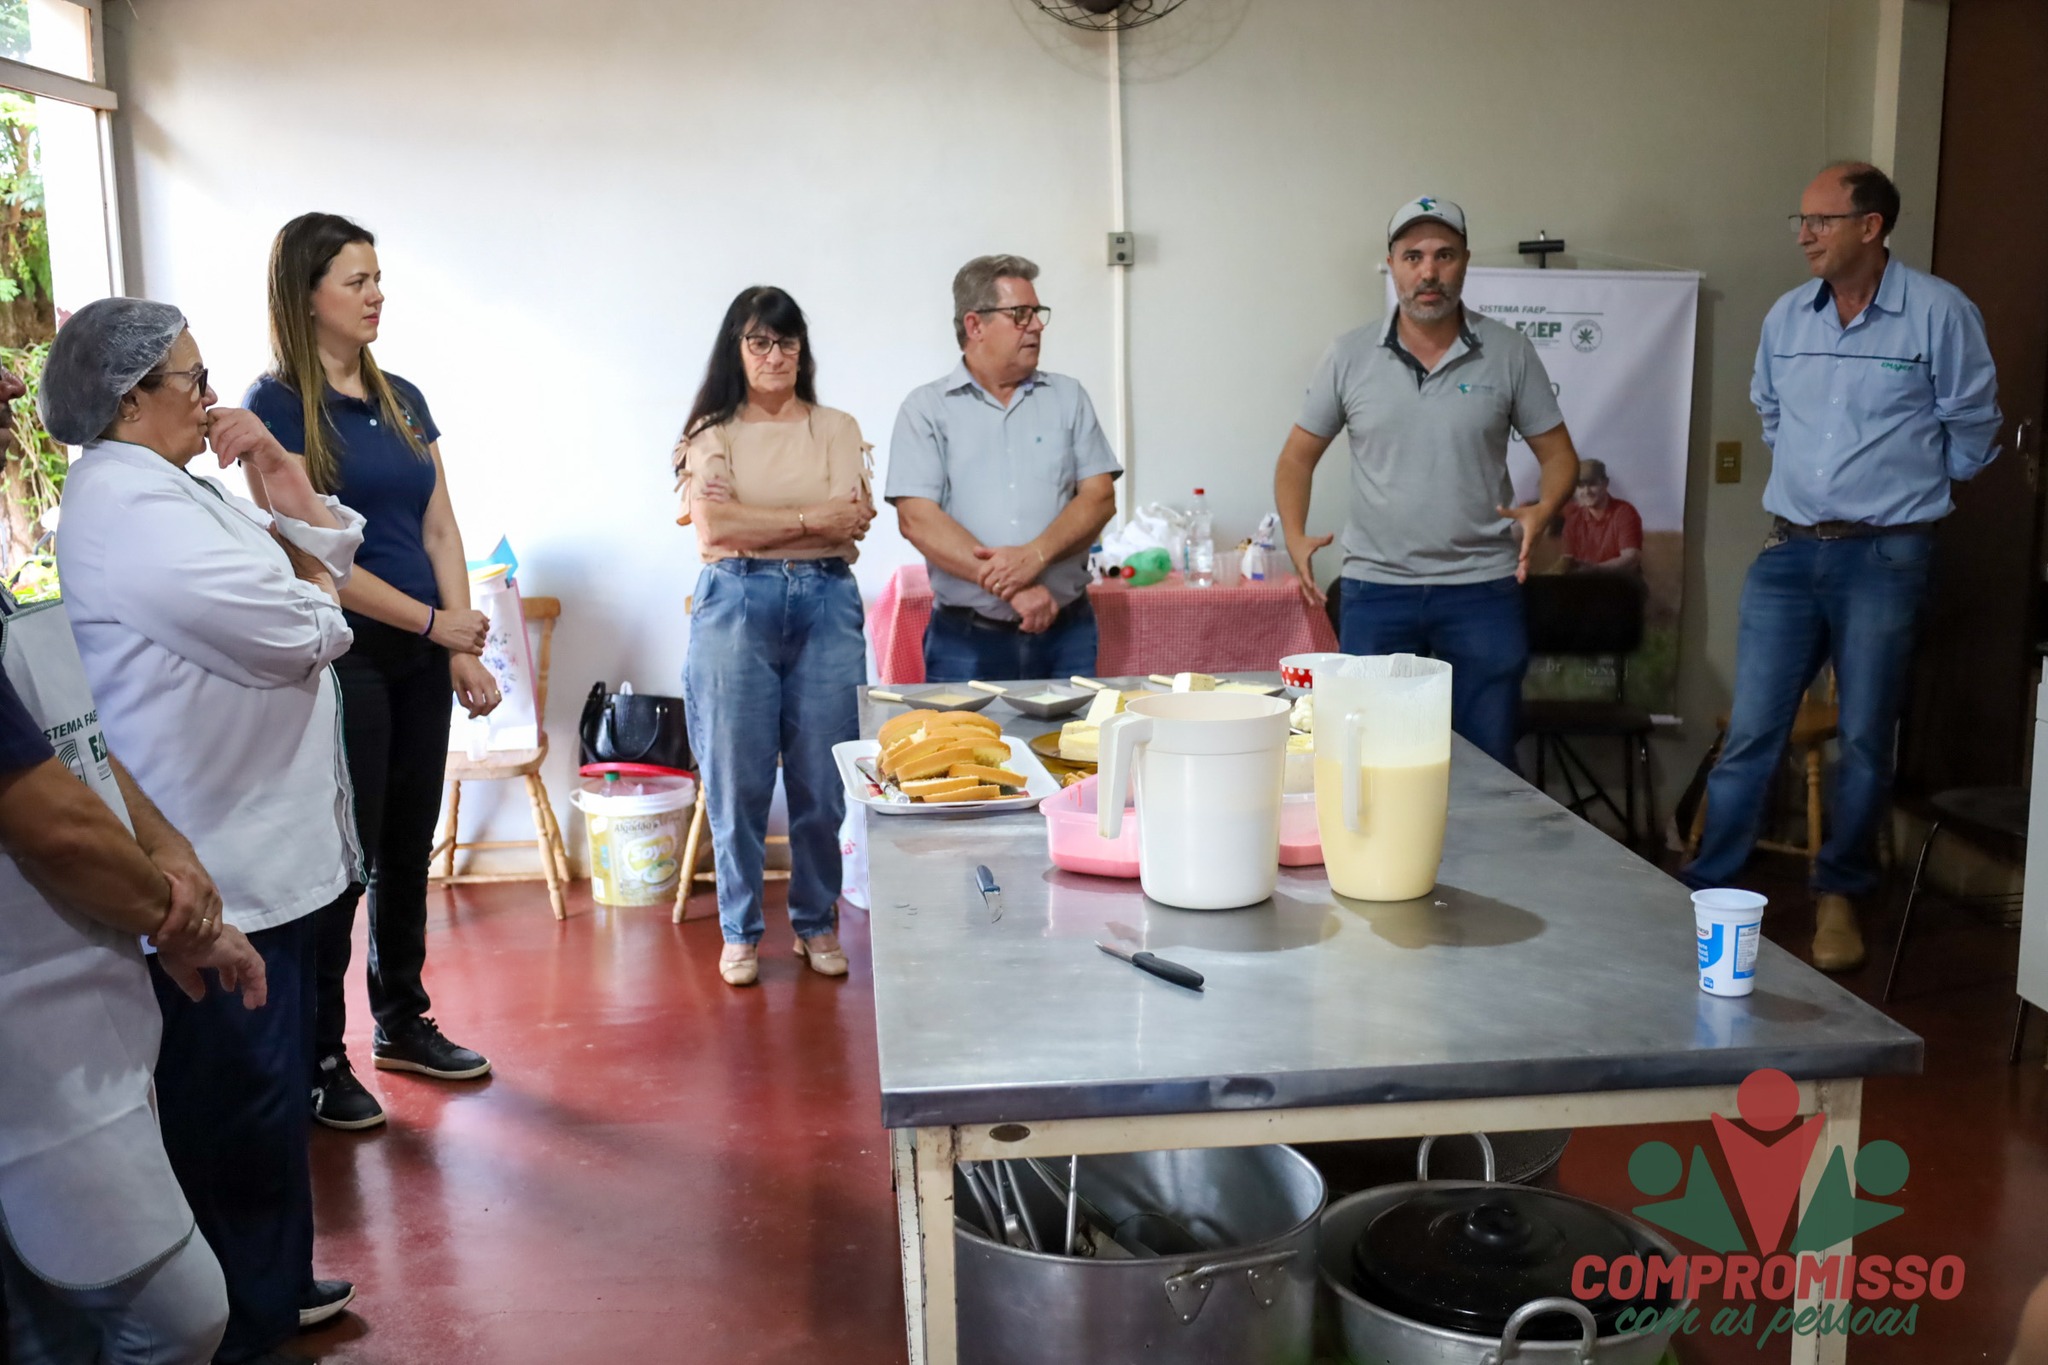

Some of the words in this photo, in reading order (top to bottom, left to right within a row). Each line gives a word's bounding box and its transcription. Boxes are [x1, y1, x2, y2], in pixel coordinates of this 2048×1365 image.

[1479, 304, 1519, 313] SISTEMA
[1522, 306, 1546, 314] FAEP
[1515, 321, 1562, 338] FAEP
[43, 717, 83, 741] STEMA
[84, 709, 98, 726] FAE
